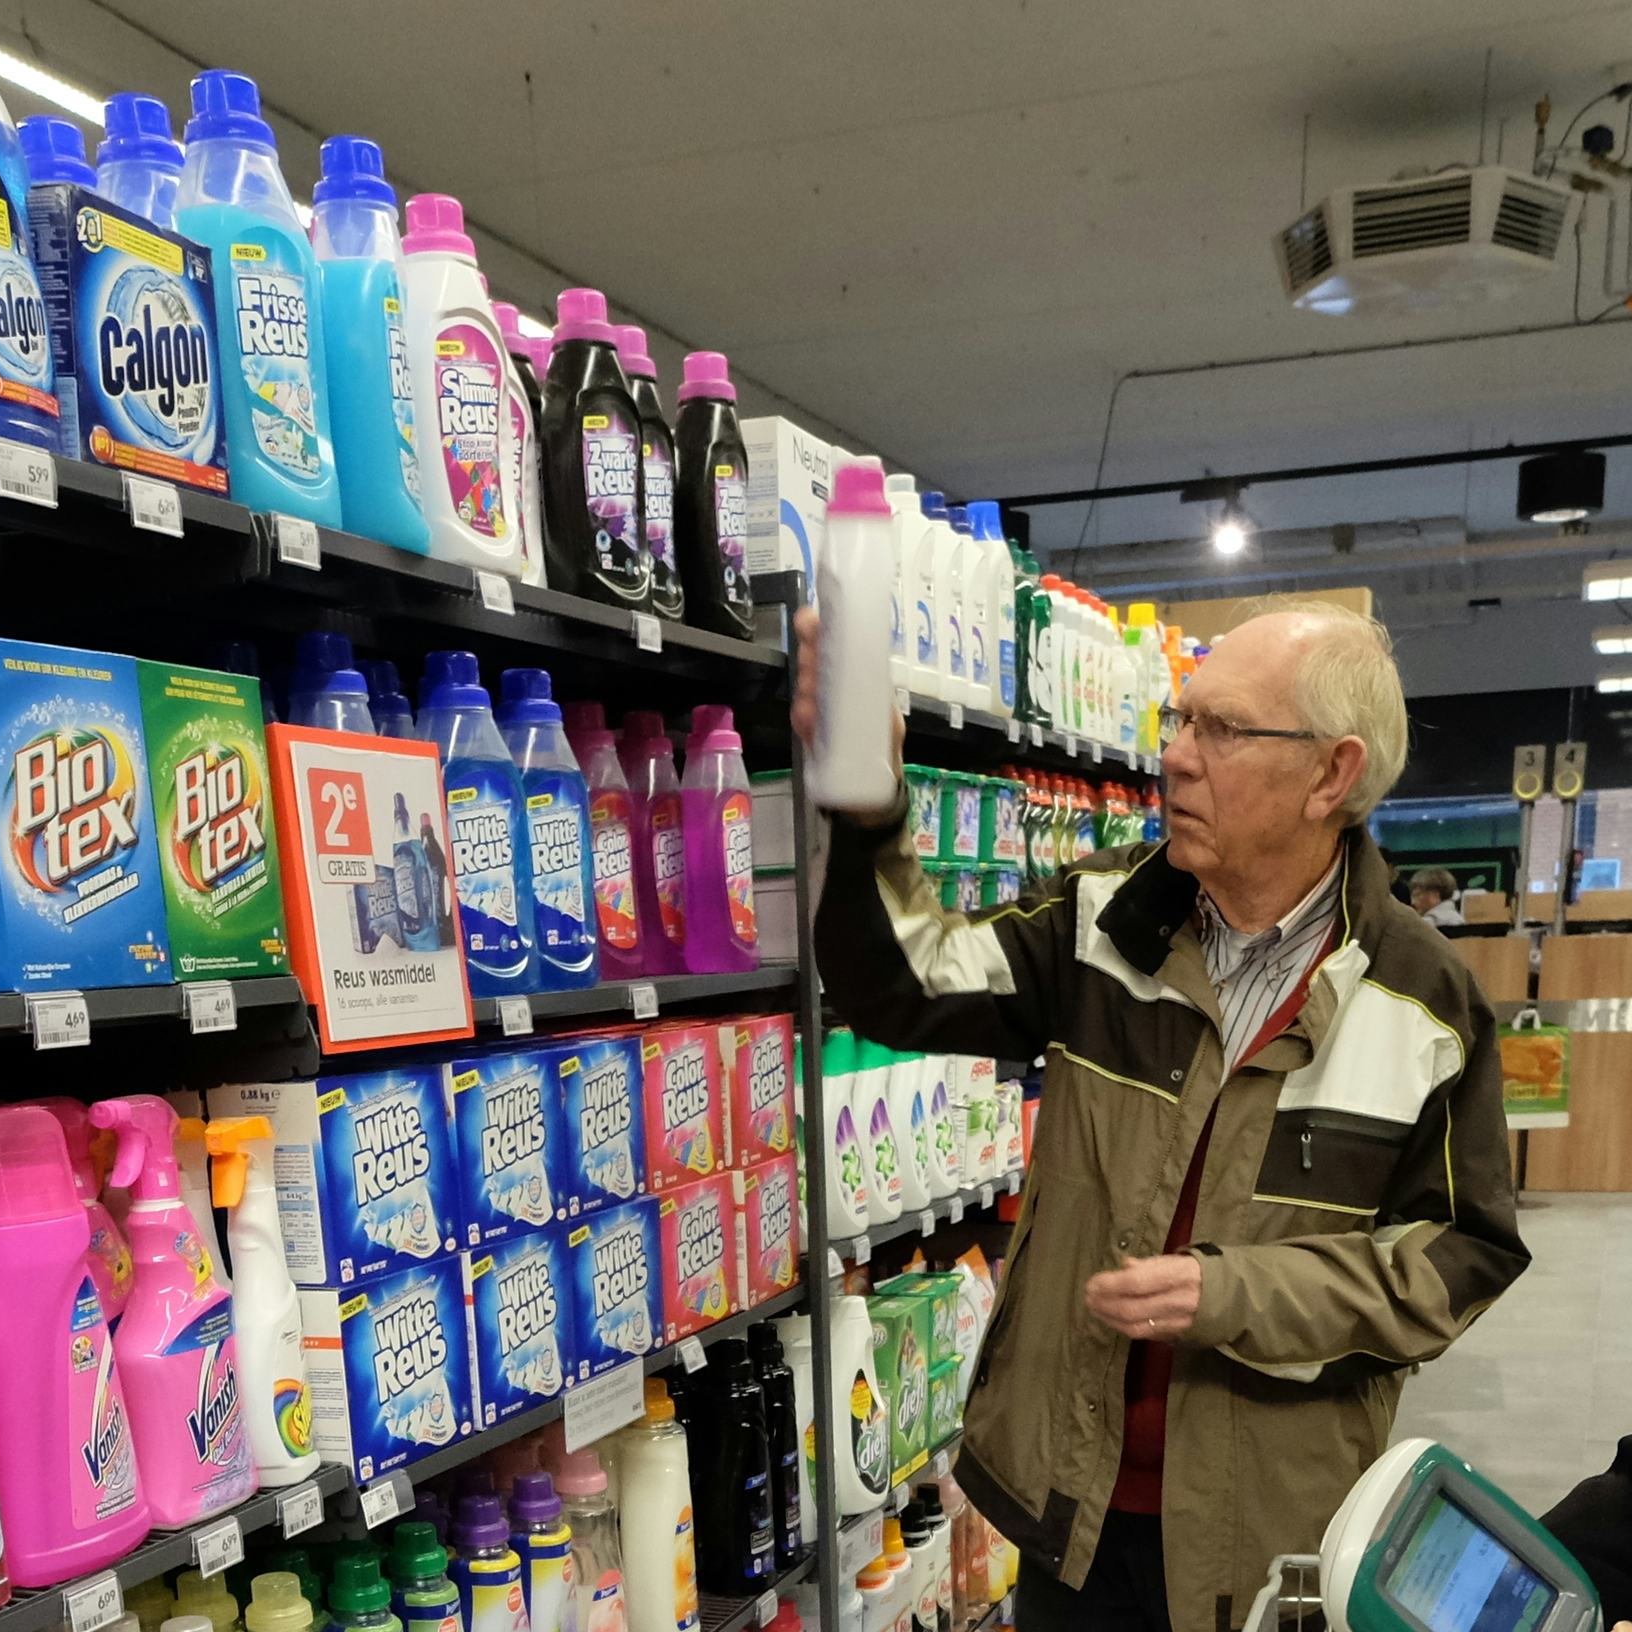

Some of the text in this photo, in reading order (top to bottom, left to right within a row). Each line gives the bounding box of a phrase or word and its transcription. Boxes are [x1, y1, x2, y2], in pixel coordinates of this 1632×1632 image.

[238, 276, 308, 322] Frisse
[239, 311, 309, 358] Reus
[98, 297, 209, 417] Calgon
[441, 367, 499, 403] Slimme
[440, 395, 498, 435] Reus
[588, 439, 637, 472] Zwarte
[586, 462, 636, 497] Reus
[1525, 751, 1535, 766] 3
[1564, 750, 1575, 764] 4
[15, 734, 108, 834] Bio
[175, 746, 244, 841] Bio
[46, 792, 139, 880] tex
[199, 801, 265, 881] tex
[457, 813, 507, 845] Witte
[534, 816, 580, 849] Witte
[328, 861, 366, 876] GRATIS
[454, 839, 513, 877] Reus
[532, 840, 581, 878] Reus
[334, 962, 436, 990] Reus wasmiddel
[583, 1068, 626, 1109] Witte
[665, 1054, 703, 1093] Color
[749, 1067, 786, 1113] Reus
[486, 1084, 540, 1128] Witte
[580, 1094, 631, 1153] Reus
[662, 1078, 708, 1132] Reus
[355, 1102, 421, 1152] Witte
[481, 1112, 545, 1177] Reus
[353, 1133, 429, 1206] Reus
